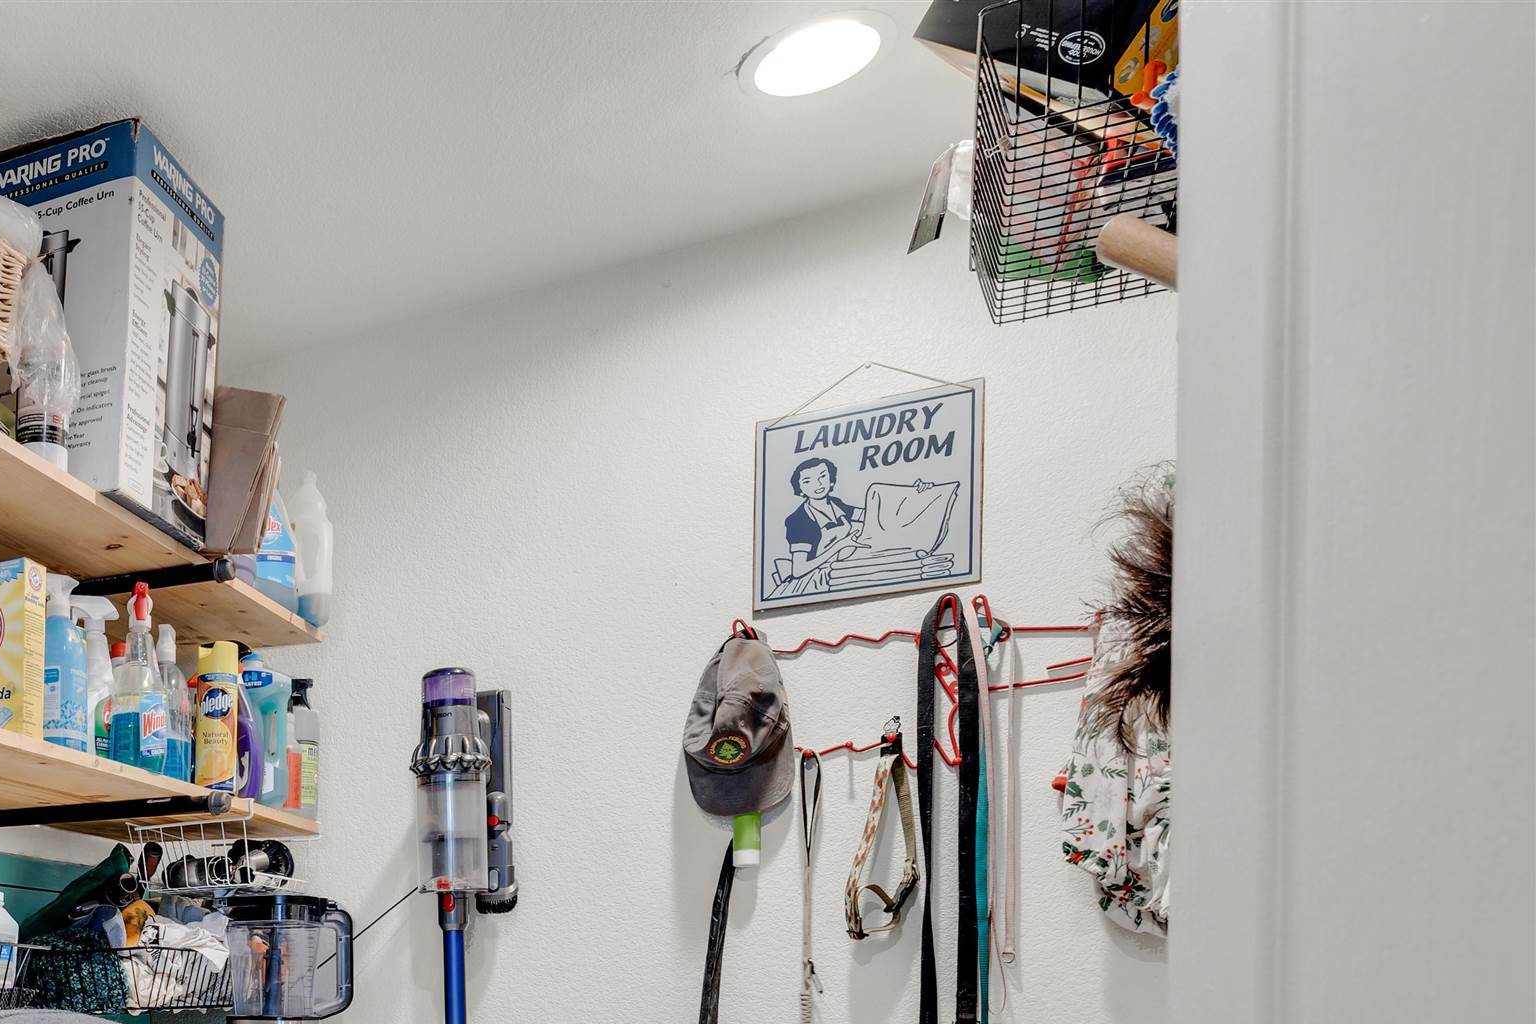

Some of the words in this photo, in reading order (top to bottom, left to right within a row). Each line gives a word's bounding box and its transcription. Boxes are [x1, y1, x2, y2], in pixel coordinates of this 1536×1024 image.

[67, 138, 107, 168] PRO
[3, 179, 60, 200] OFESSIONAL
[64, 162, 106, 181] QUALITY
[153, 145, 194, 202] WARING
[195, 194, 216, 226] PRO
[66, 196, 94, 211] Coffee
[96, 189, 115, 202] Urn
[794, 402, 944, 454] LAUNDRY
[859, 430, 956, 471] ROOM
[200, 692, 233, 722] pledge
[202, 731, 229, 739] Natural
